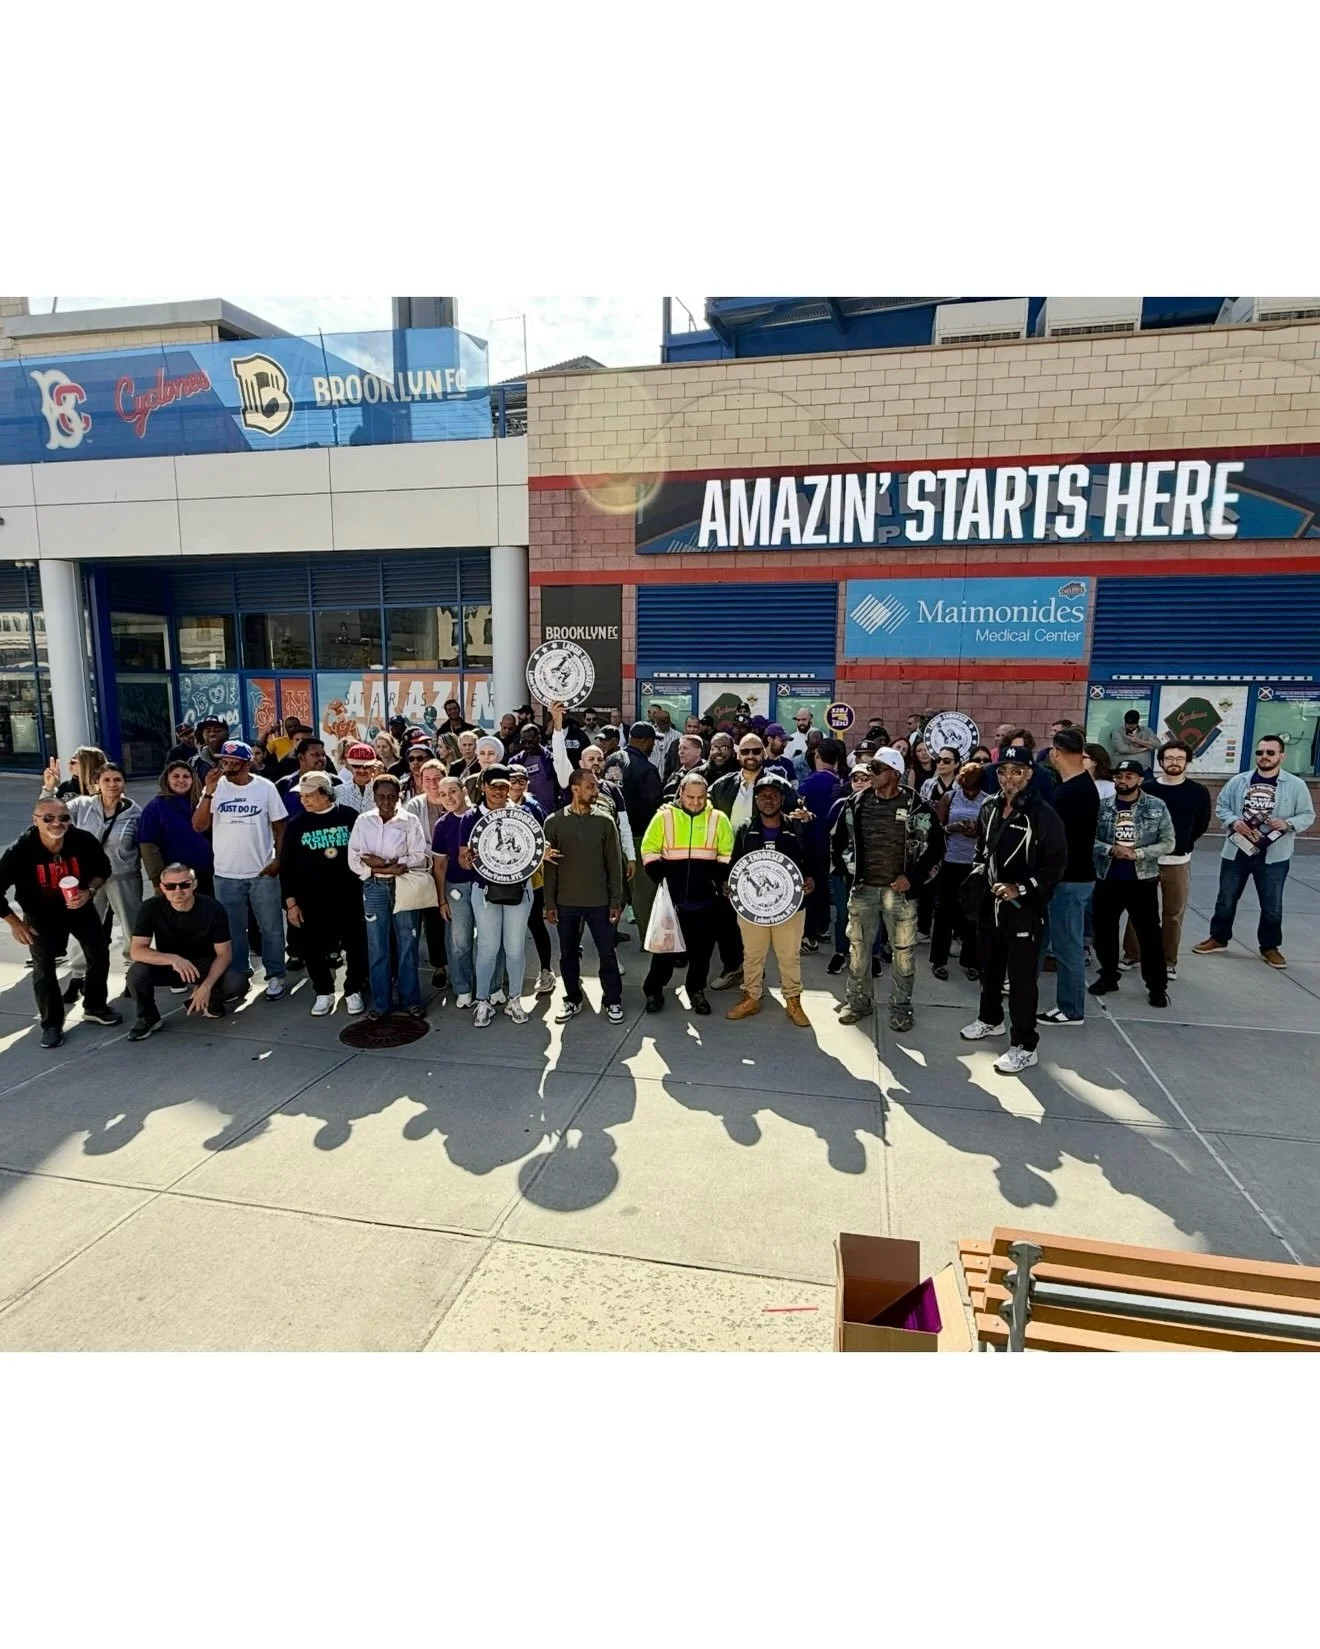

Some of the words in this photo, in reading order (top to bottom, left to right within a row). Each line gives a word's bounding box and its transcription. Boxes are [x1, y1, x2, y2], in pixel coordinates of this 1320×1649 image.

[312, 370, 443, 406] BROOKLYN
[444, 368, 467, 393] FC
[114, 367, 211, 438] Cyclones
[697, 472, 891, 547] AMAZIN'
[905, 465, 1089, 541] STARTS
[1104, 460, 1245, 537] HERE
[917, 598, 1084, 623] Maimonides
[546, 626, 606, 639] BROOKLYN
[608, 626, 618, 637] FC
[976, 629, 1029, 642] Medical
[1035, 628, 1081, 642] Center
[484, 810, 540, 834] LABOR-ENDORSED
[301, 832, 351, 845] WORKER
[309, 839, 349, 849] UNITED
[732, 852, 784, 879] LABOR-ENDORSED
